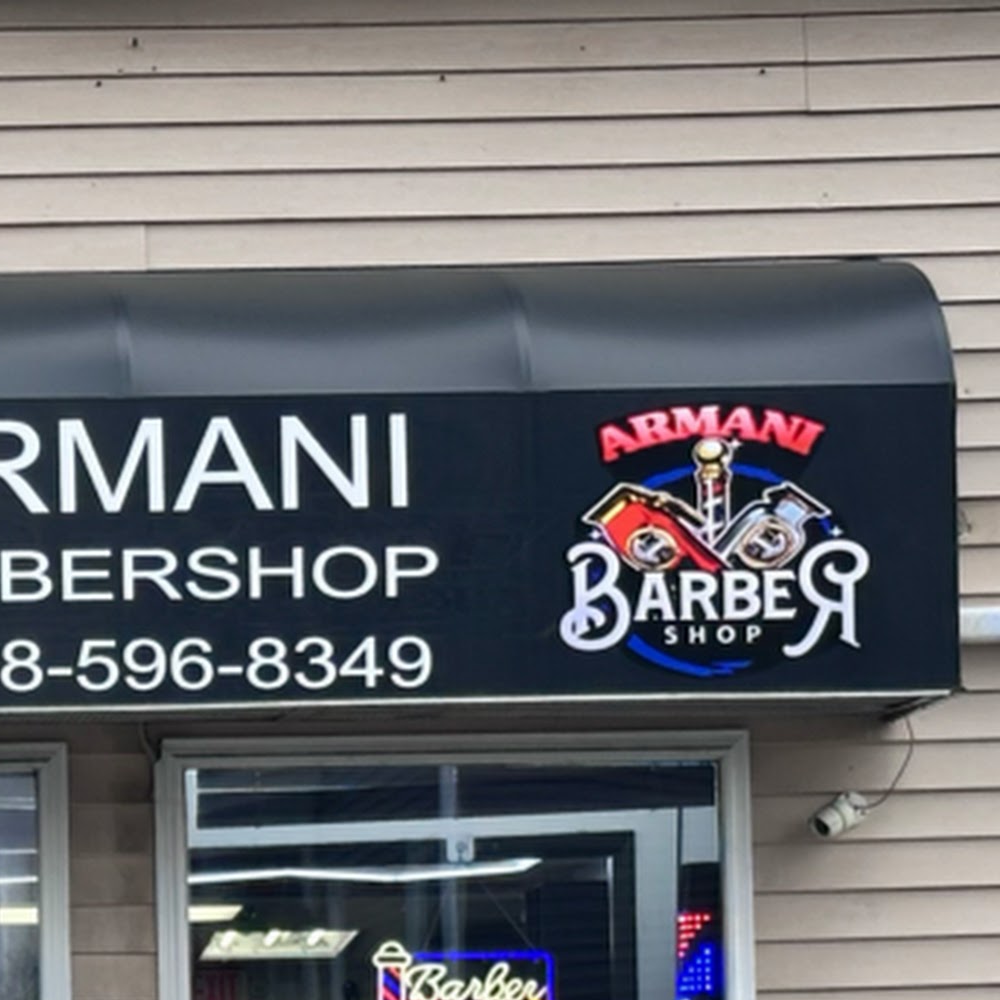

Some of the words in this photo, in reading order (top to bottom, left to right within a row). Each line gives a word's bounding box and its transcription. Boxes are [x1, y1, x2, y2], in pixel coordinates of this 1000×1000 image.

[599, 405, 825, 463] ARMANI
[559, 538, 870, 658] BARBER
[664, 624, 763, 645] SHOP
